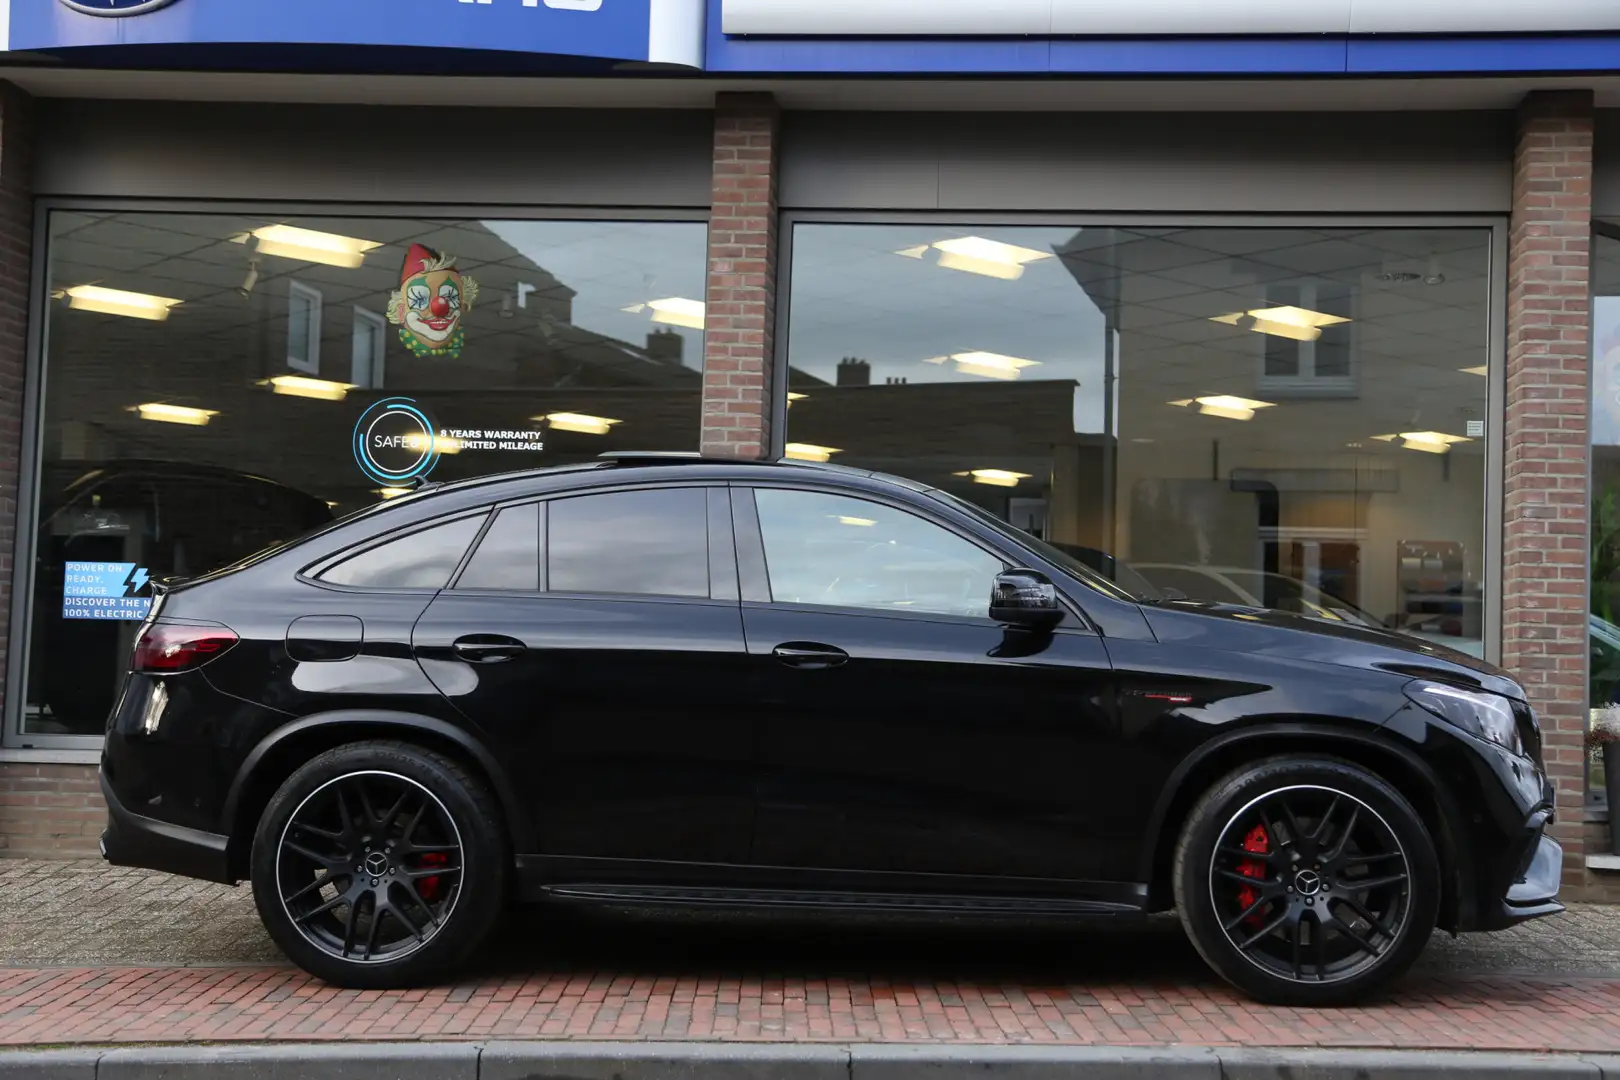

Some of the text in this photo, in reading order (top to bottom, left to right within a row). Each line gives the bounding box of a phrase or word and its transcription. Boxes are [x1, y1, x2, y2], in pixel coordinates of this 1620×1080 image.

[441, 430, 541, 440] 8 YEARS WARRANTY
[440, 440, 544, 450] LIMITED MILEAGE
[66, 563, 105, 572] POWER
[66, 574, 104, 583] READY.
[65, 586, 108, 595] CHARGE
[65, 597, 116, 607] DISCOVER
[120, 599, 140, 608] THE
[64, 609, 143, 618] 100% ELECTRIC
